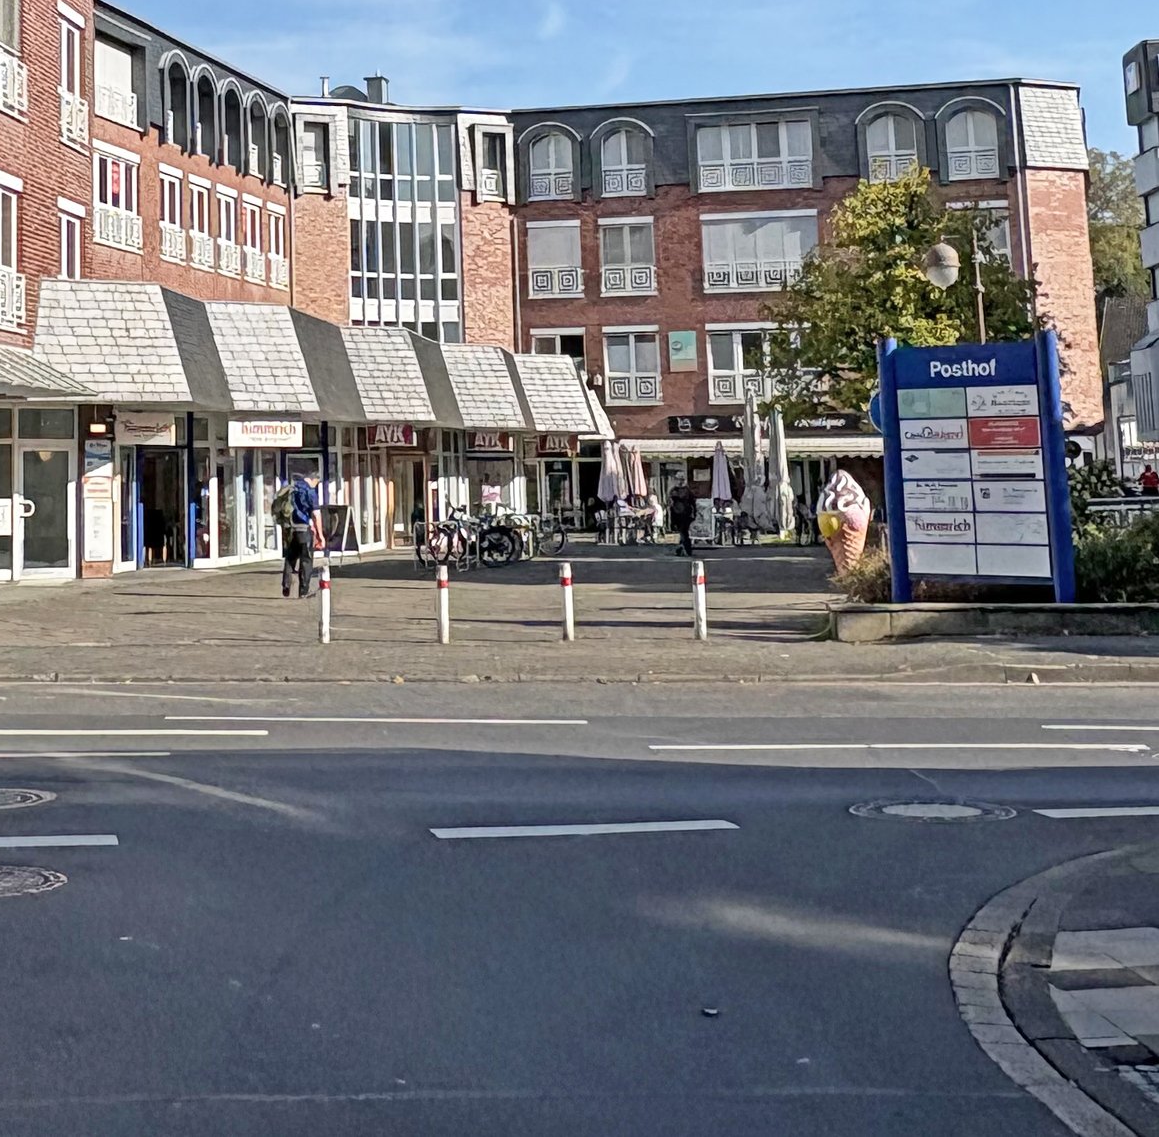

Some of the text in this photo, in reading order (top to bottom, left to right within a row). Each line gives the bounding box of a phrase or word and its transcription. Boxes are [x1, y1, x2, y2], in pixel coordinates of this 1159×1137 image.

[930, 358, 996, 378] Posthof
[374, 424, 406, 444] AYK
[474, 432, 501, 449] AYK
[545, 435, 570, 451] AYK
